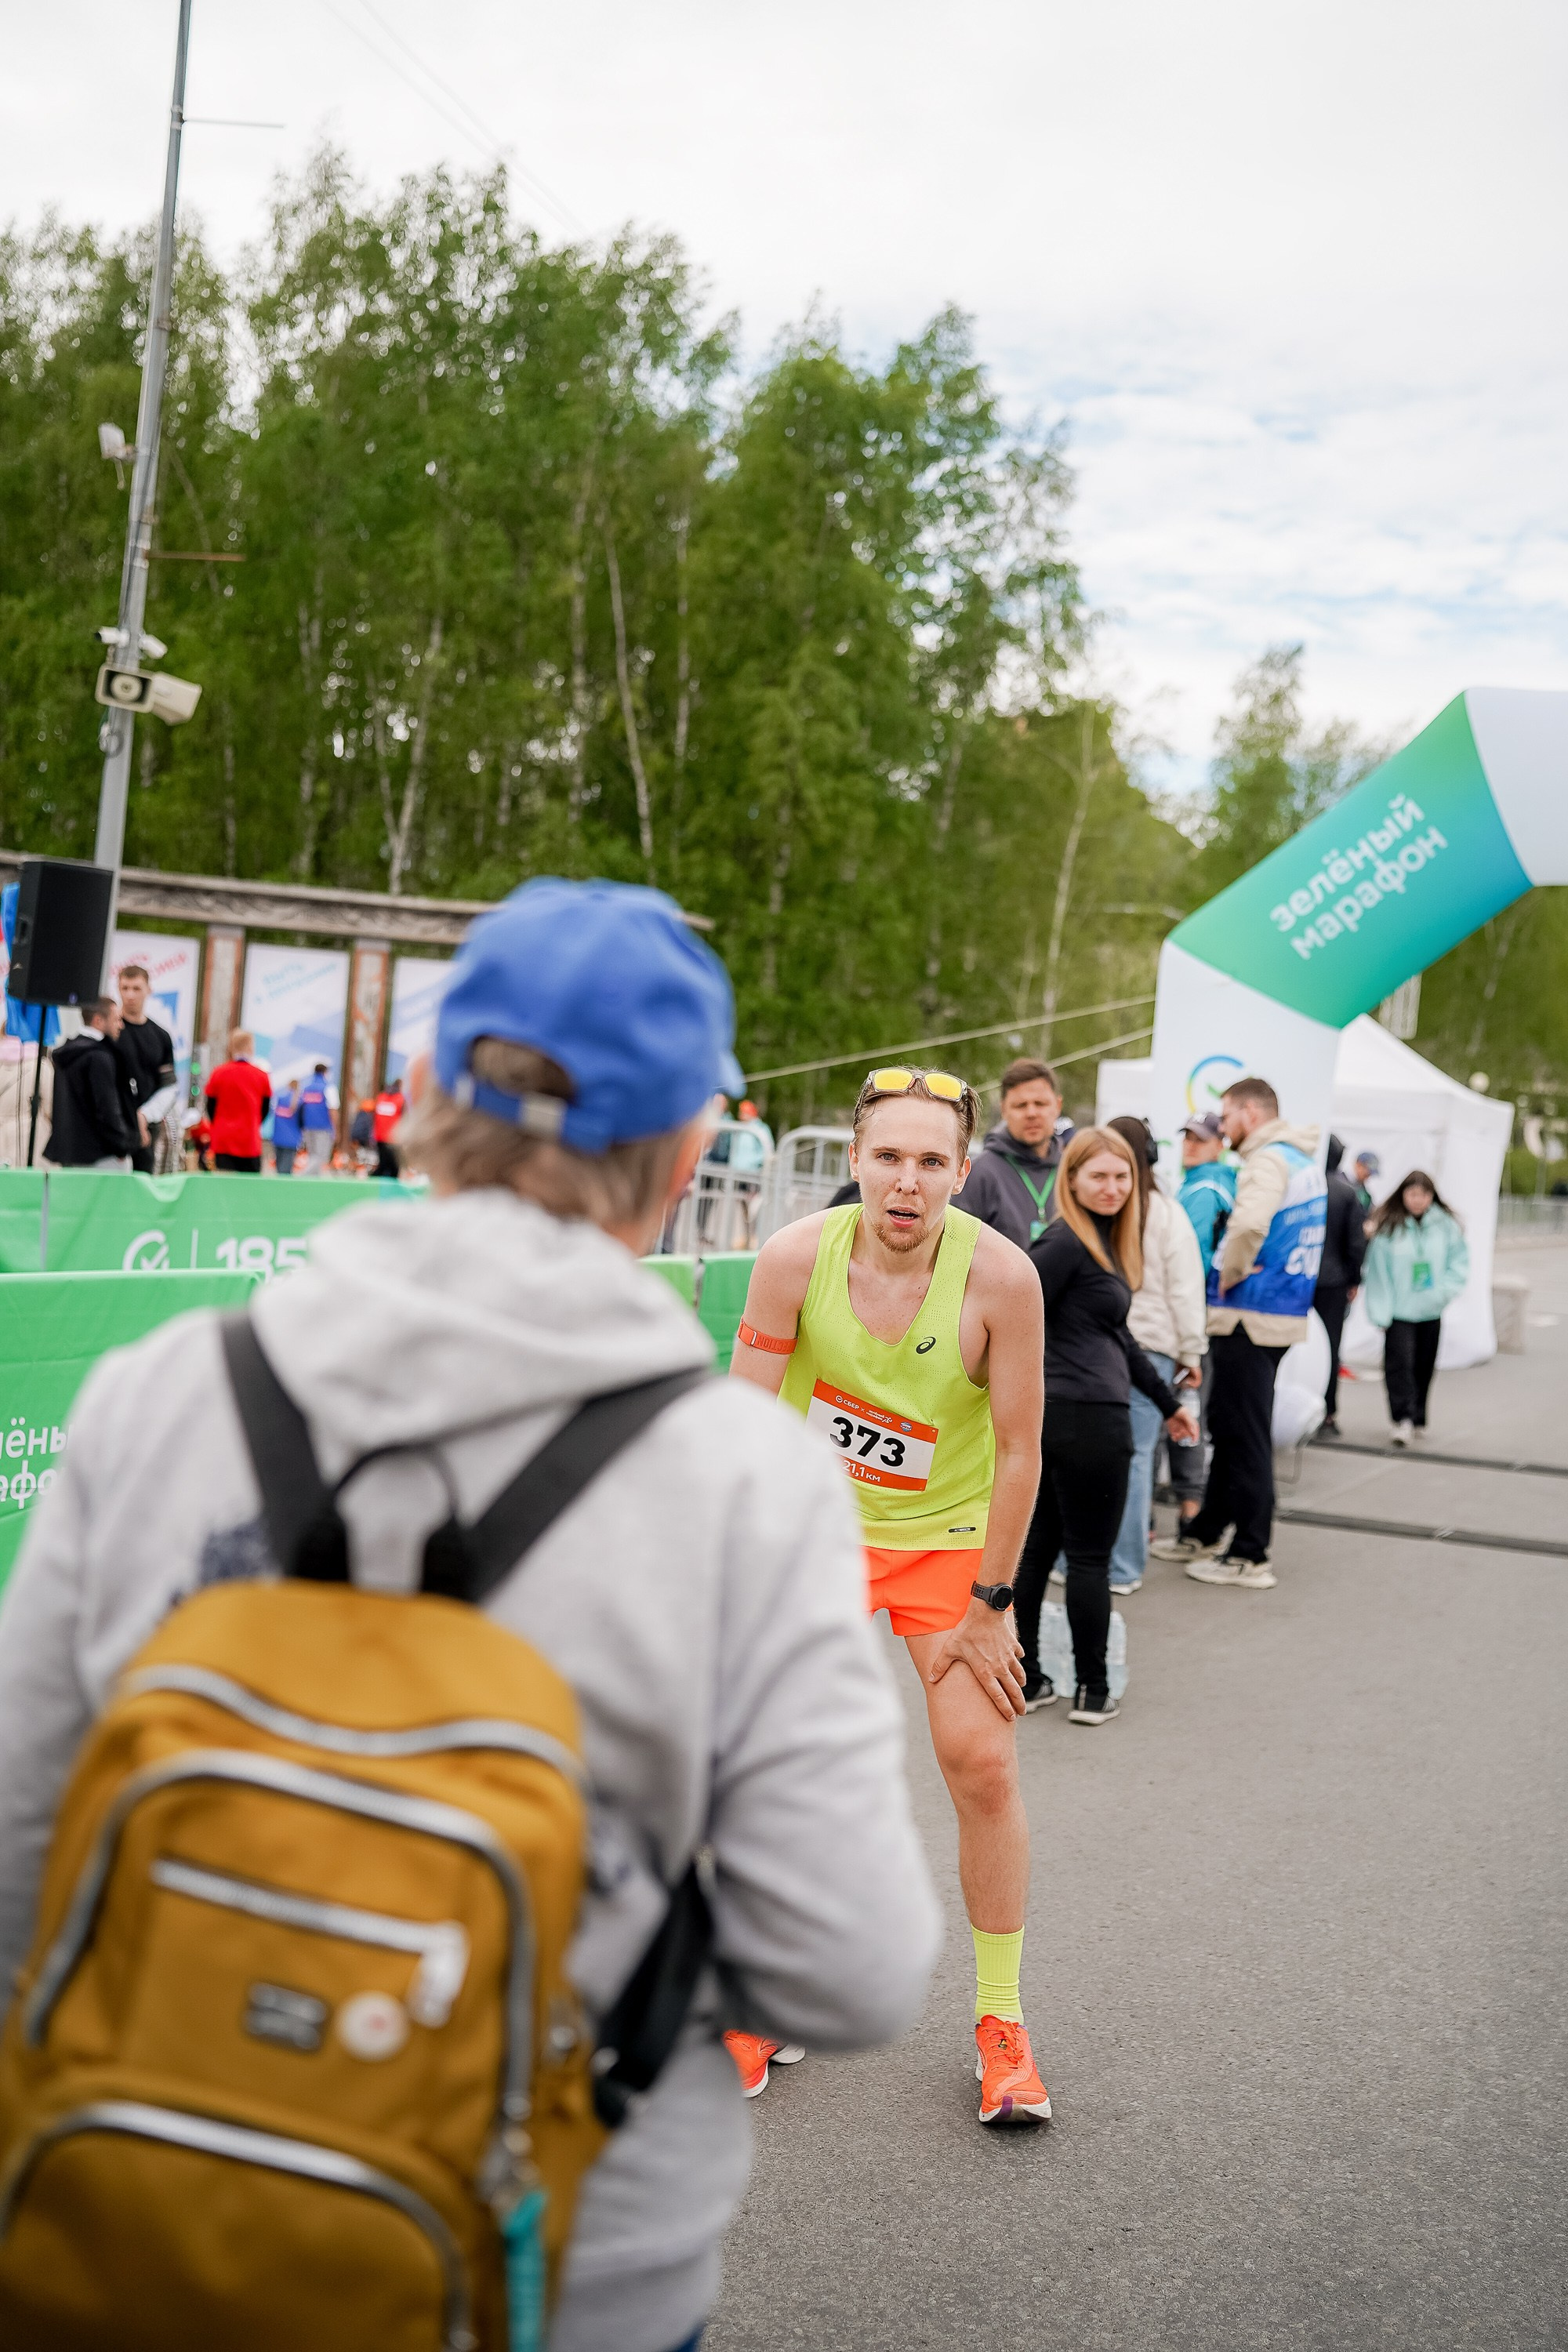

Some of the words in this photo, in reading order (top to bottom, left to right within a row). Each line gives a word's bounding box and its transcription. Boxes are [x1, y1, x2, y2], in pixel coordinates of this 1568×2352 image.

[1270, 793, 1425, 931] зелёный
[1291, 826, 1448, 960] марафон
[829, 1416, 906, 1468] 373
[843, 1399, 859, 1410] СБЕР
